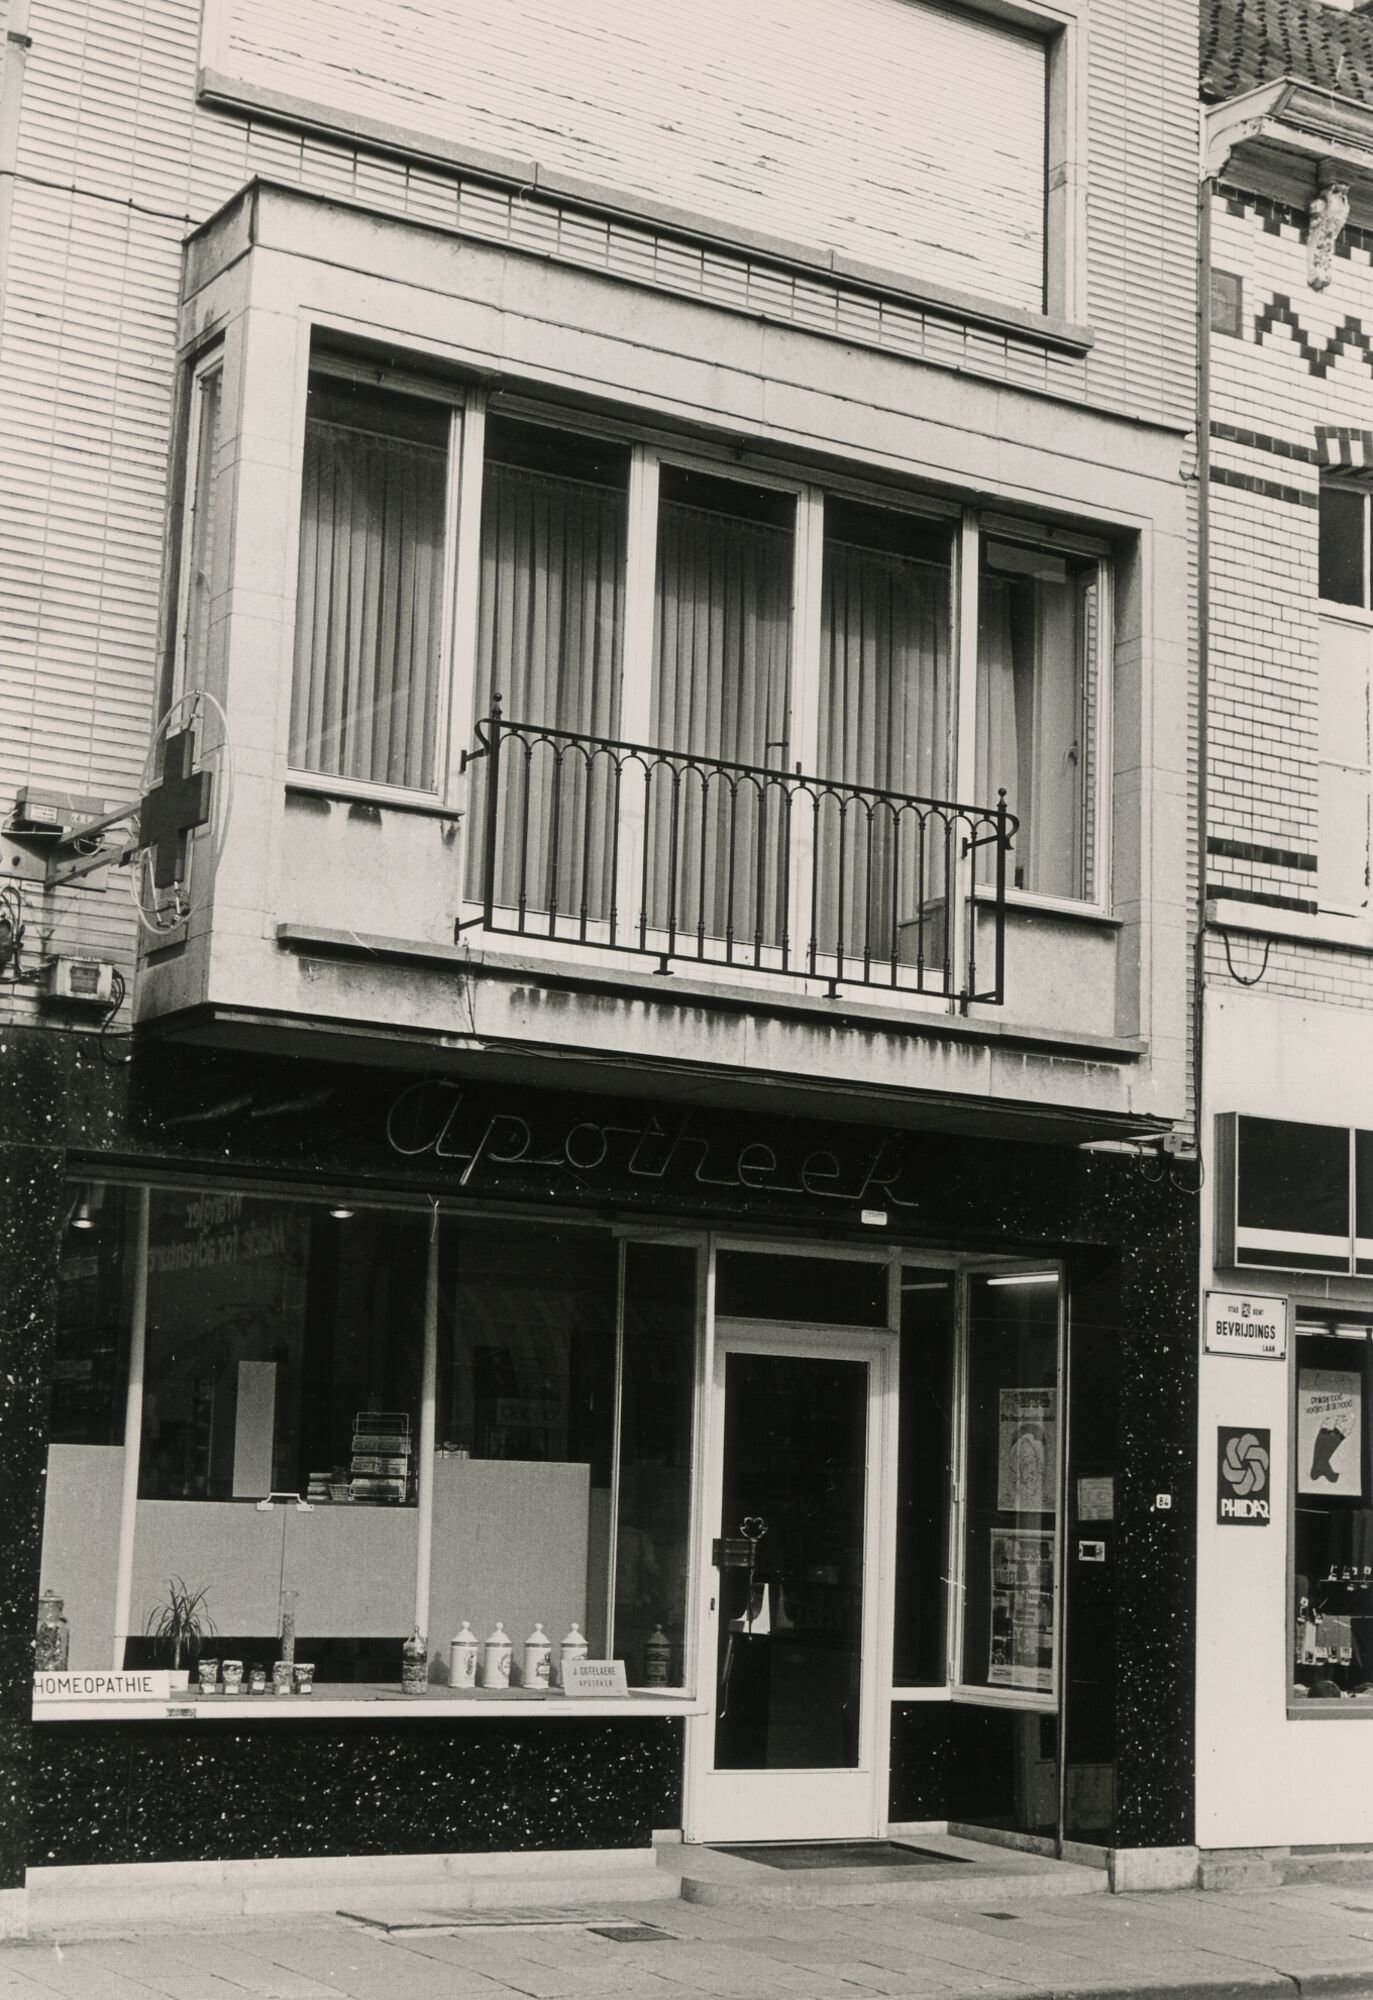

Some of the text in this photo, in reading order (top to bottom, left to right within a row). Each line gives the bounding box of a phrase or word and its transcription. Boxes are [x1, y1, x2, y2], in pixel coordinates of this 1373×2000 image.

[1216, 1321, 1276, 1340] BEVRIJDINGS
[1262, 1344, 1276, 1353] LAAN
[33, 1676, 153, 1695] HOMEOPATHIE
